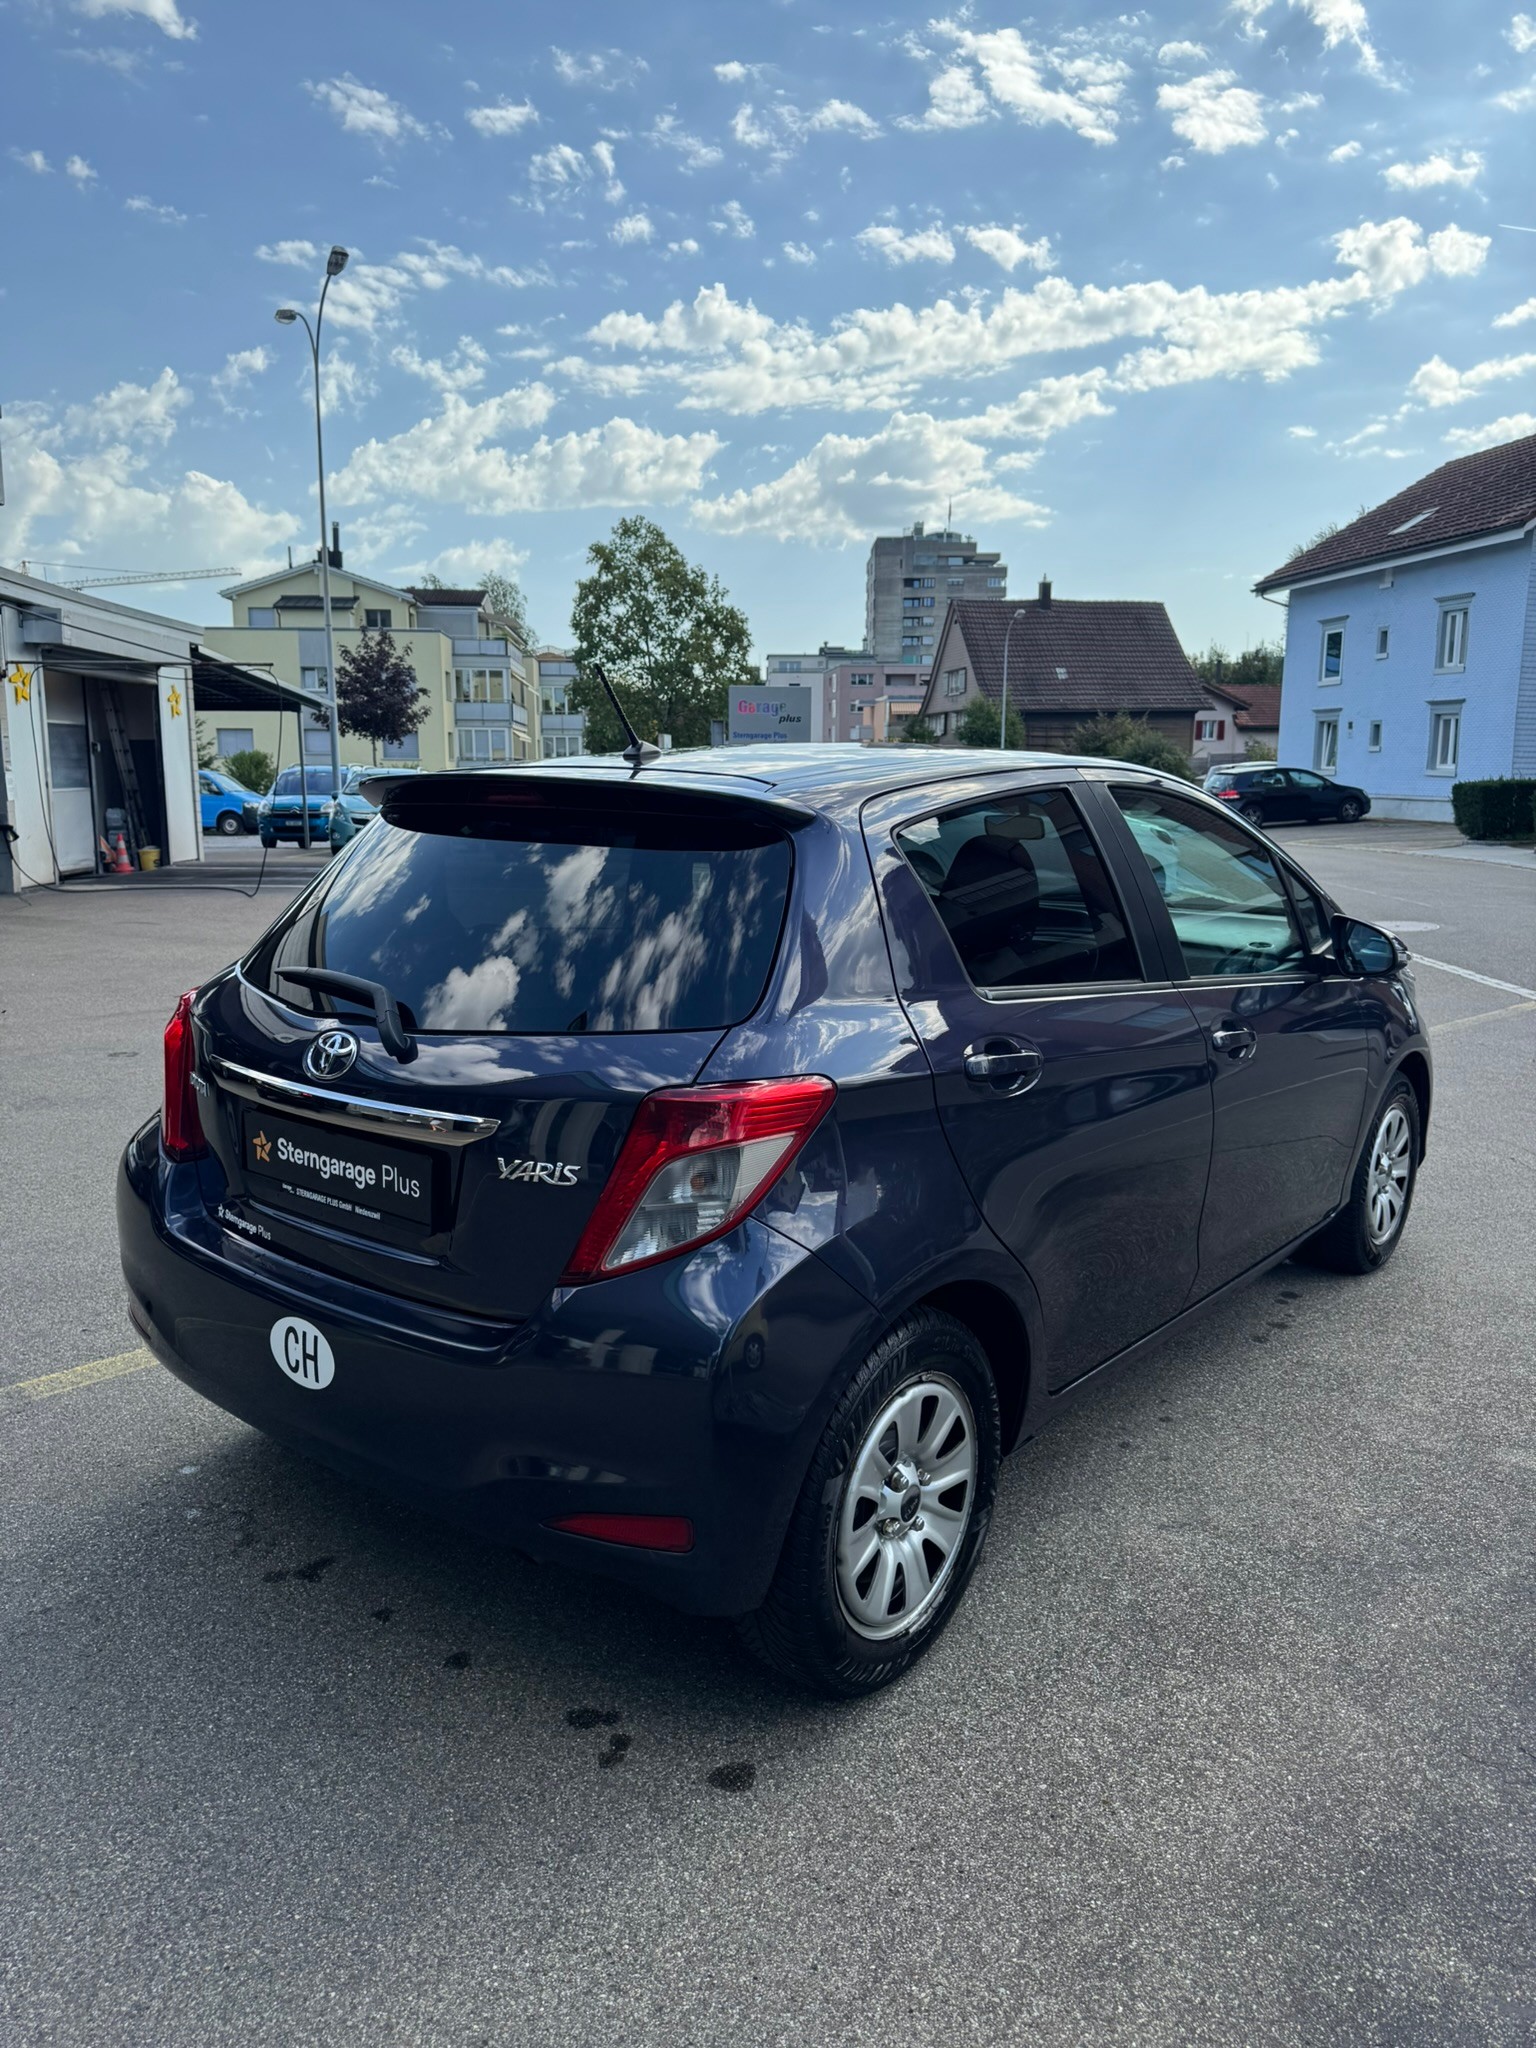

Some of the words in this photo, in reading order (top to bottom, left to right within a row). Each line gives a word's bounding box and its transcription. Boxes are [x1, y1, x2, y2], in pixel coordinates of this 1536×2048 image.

[738, 700, 787, 717] Garage
[778, 714, 802, 724] plus
[733, 731, 772, 740] Sterngarage
[773, 731, 788, 739] Plus
[277, 1137, 376, 1190] Sterngarage
[382, 1164, 420, 1198] Plus
[296, 1187, 327, 1204] STERNGARAGE
[326, 1197, 339, 1207] PLUS
[338, 1200, 353, 1212] GmbH
[224, 1209, 257, 1235] Sterngarage
[257, 1224, 271, 1241] Plus
[284, 1325, 319, 1383] CH
